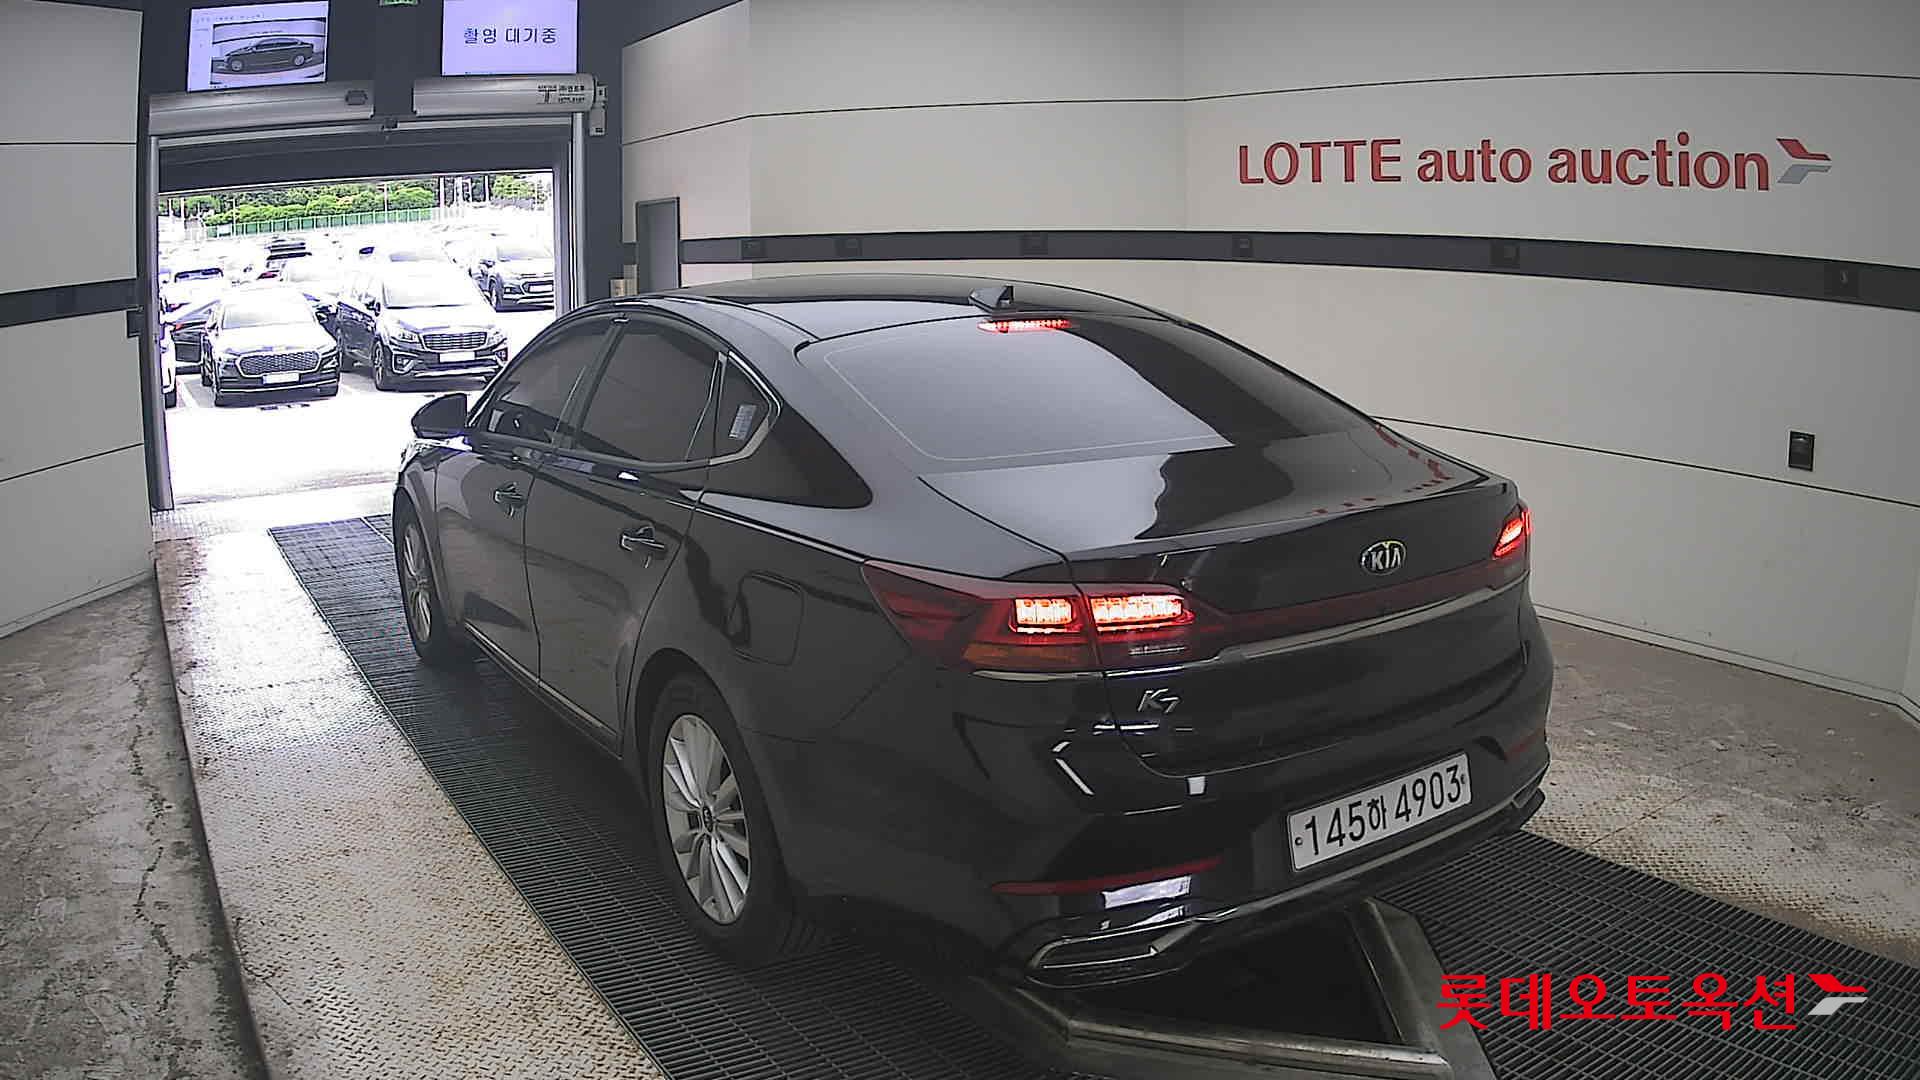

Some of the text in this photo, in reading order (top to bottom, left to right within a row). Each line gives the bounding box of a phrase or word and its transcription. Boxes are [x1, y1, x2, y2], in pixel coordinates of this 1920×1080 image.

[464, 27, 557, 44] 촬영 대기중
[1239, 131, 1770, 191] LOTTE auto auction
[1370, 545, 1401, 570] KIA
[1137, 688, 1180, 714] K7
[1394, 764, 1462, 822] 4903
